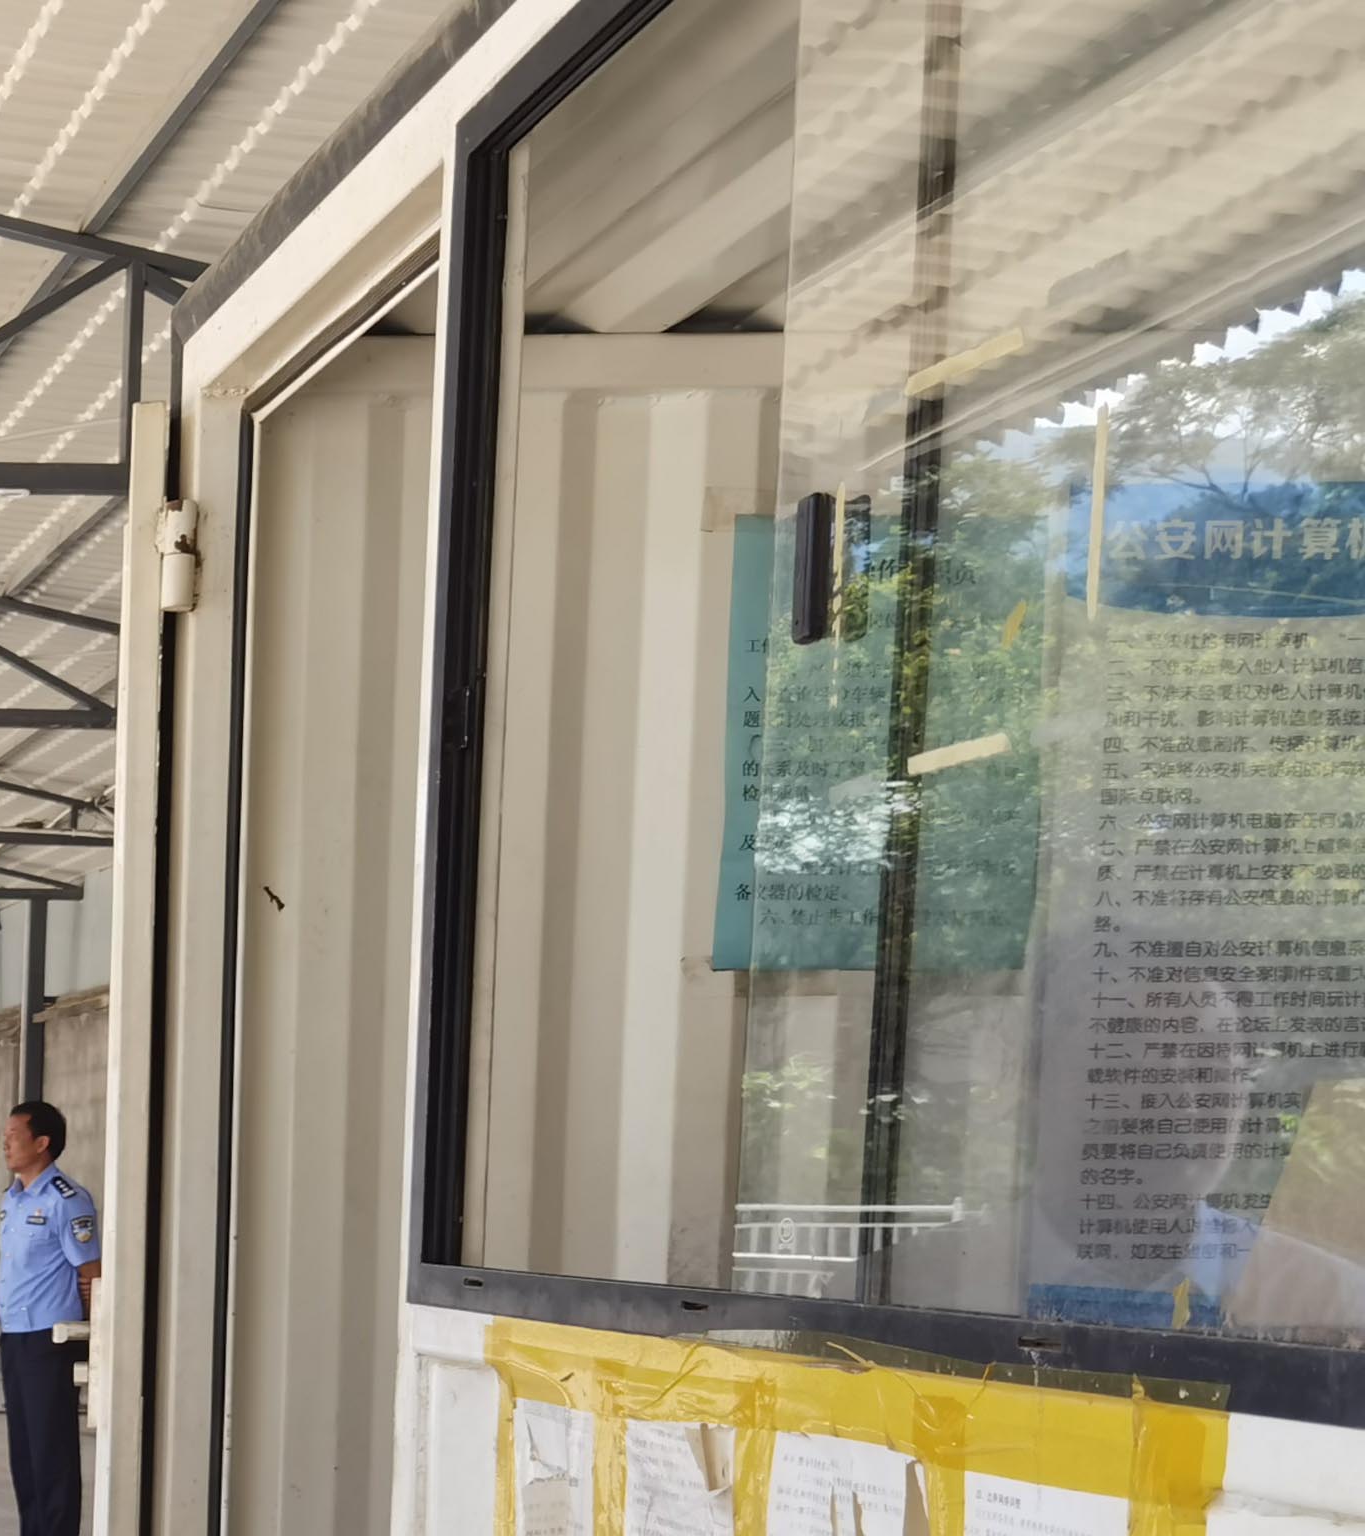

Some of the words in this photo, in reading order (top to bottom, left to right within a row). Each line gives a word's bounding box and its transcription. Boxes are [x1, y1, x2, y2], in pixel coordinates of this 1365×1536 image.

[1092, 991, 1365, 1010] 十一、所有人员不得工作时间玩计
[1088, 1016, 1365, 1034] 不健康的内容，在论坛上发表的言
[1087, 1041, 1365, 1060] 十二、严禁在因特网计算机上进行
